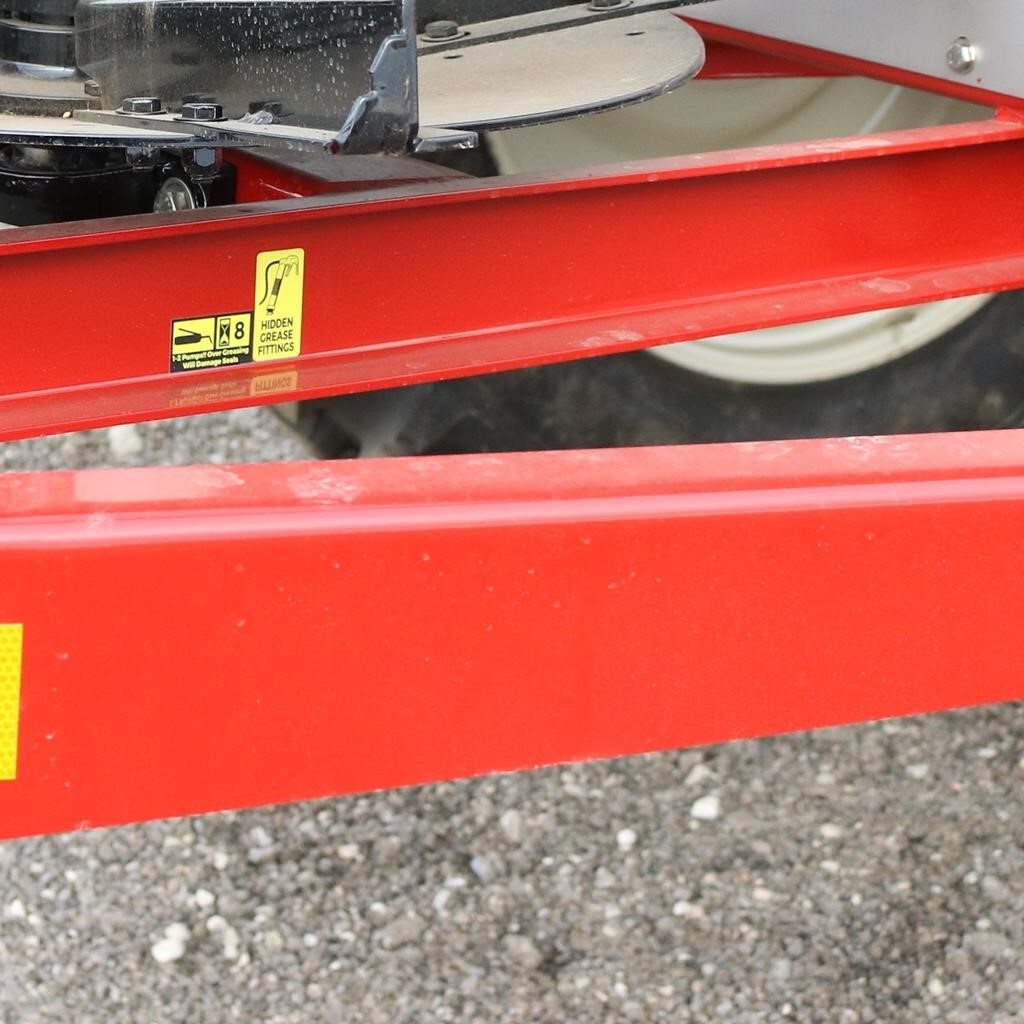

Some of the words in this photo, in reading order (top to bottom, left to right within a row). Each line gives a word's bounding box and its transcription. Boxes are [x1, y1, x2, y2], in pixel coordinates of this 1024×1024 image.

[234, 321, 245, 340] 8
[261, 317, 293, 330] HIDDEN
[260, 329, 293, 343] GREASE
[207, 350, 222, 359] Over
[222, 347, 249, 357] Greasing
[258, 342, 295, 356] FITTINGS
[182, 360, 196, 370] Will
[196, 356, 222, 367] Damage
[222, 354, 239, 364] Seals
